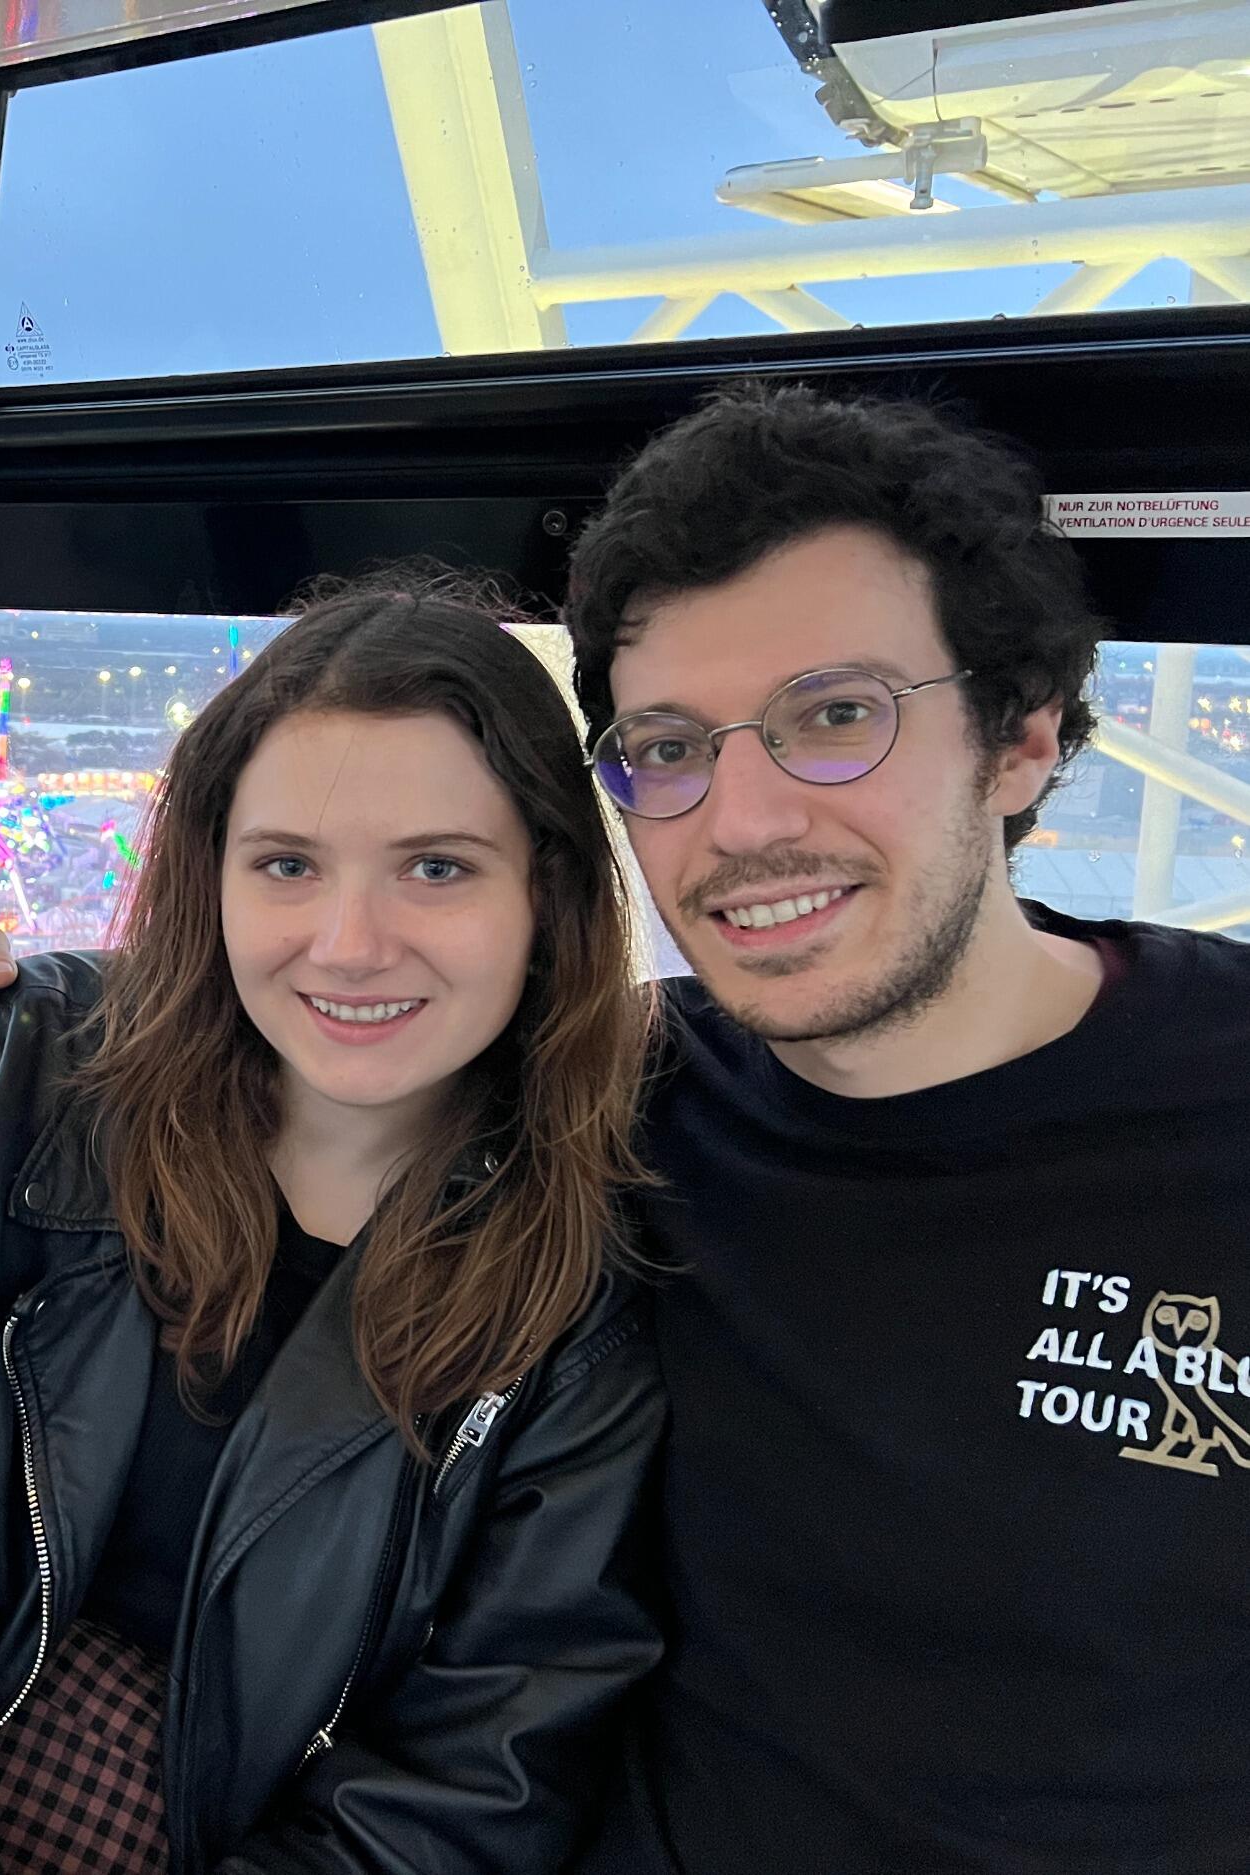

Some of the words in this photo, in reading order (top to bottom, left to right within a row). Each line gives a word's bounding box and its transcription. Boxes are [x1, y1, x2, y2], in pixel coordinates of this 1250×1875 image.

[1058, 501, 1083, 512] NUR
[1088, 501, 1113, 512] ZUR
[1116, 498, 1220, 512] NOTBELÜFTUNG
[1058, 517, 1135, 528] VENTILATION
[1138, 516, 1209, 528] D'URGENCE
[1042, 1269, 1131, 1314] IT'S
[1026, 1327, 1113, 1371] ALL
[1123, 1336, 1160, 1380] A
[1016, 1380, 1151, 1441] TOUR
